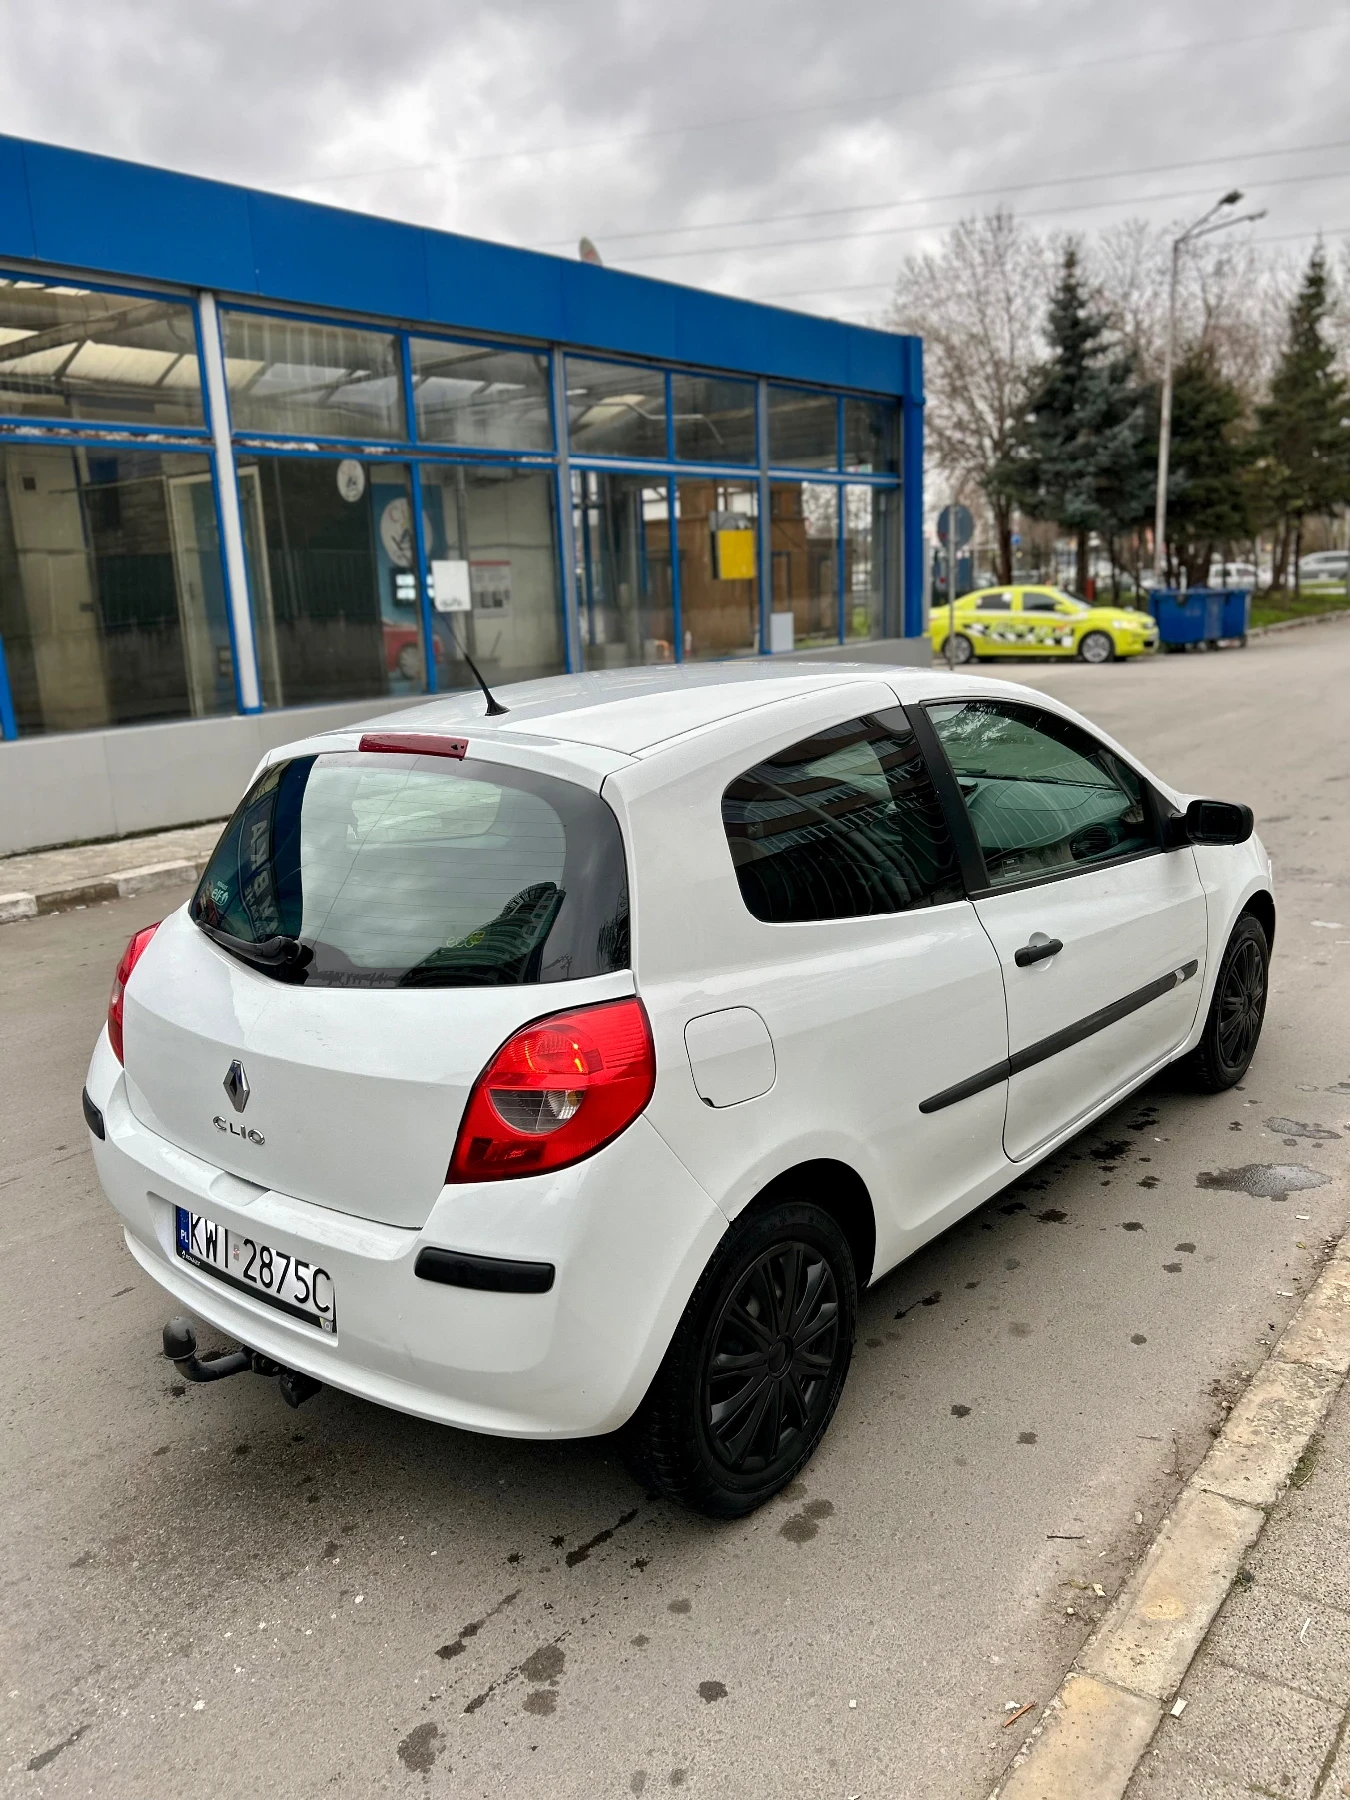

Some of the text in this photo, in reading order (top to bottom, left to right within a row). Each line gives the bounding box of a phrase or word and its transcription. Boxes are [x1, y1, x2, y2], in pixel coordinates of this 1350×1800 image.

[446, 936, 474, 948] eco
[212, 1115, 266, 1145] CLIO
[180, 1229, 189, 1243] PL
[190, 1212, 331, 1313] KWI 2875C
